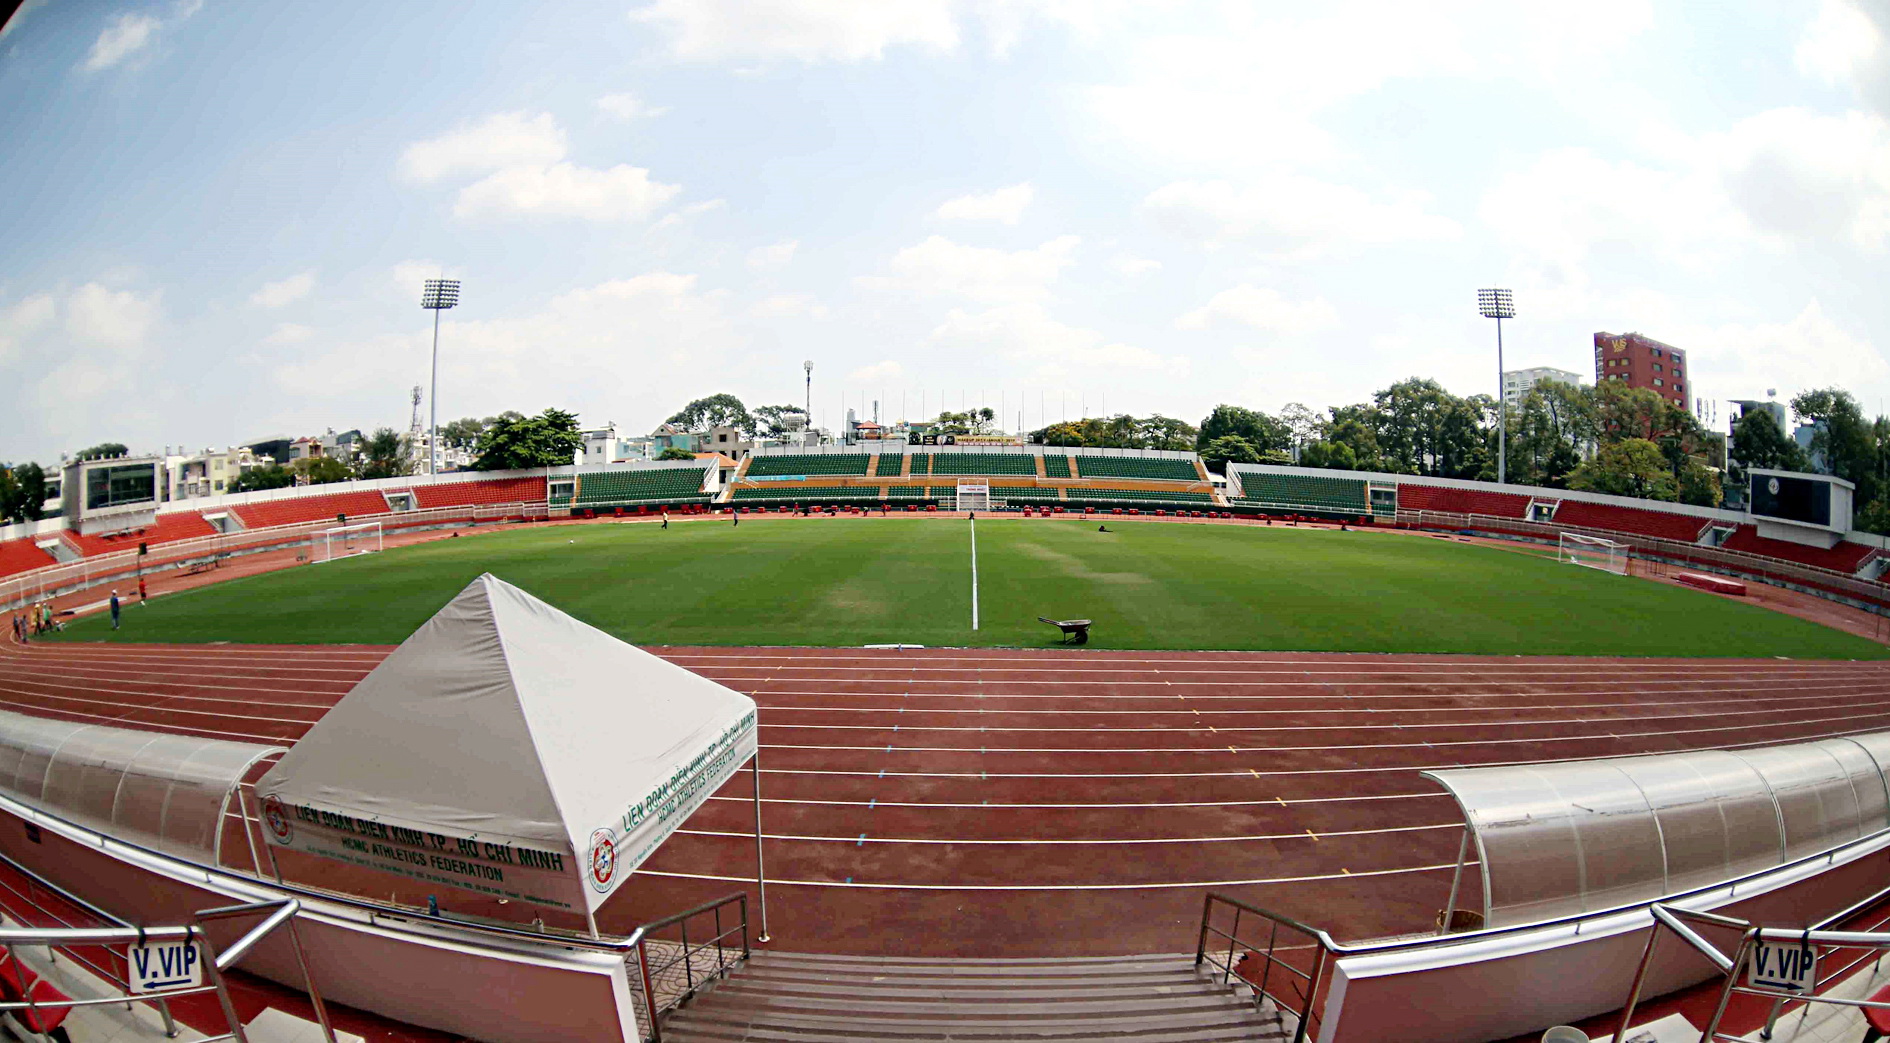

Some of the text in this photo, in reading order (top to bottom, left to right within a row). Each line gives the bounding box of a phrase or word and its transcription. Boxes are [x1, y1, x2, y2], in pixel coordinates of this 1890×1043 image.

[657, 799, 676, 825] HCMC
[677, 772, 706, 808] ATHLETICS
[706, 746, 736, 781] FEDERATION
[342, 837, 369, 854] HCMC
[371, 843, 427, 867] ATHLETICS
[430, 855, 504, 882] FEDERATION
[391, 825, 425, 848] KINH
[518, 847, 564, 872] MINH
[133, 945, 197, 979] V.VIP
[1755, 946, 1813, 981] V.VIP
